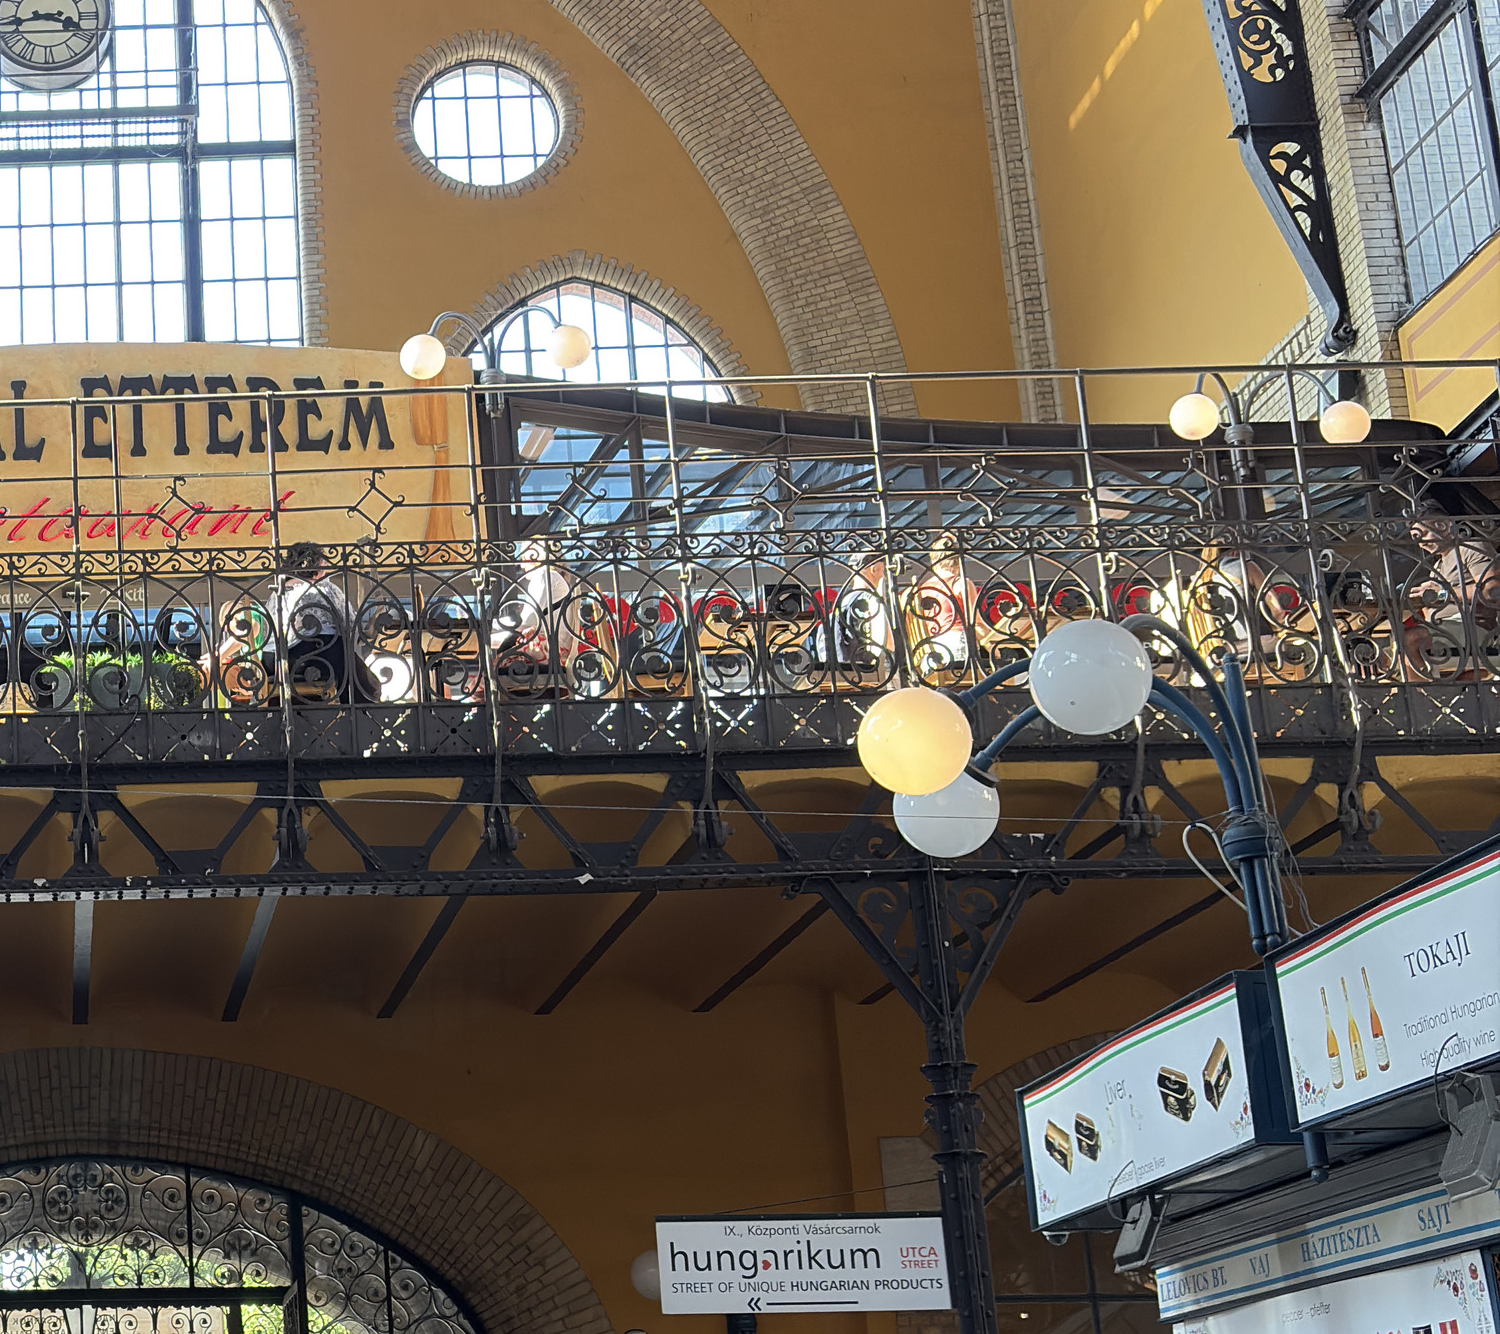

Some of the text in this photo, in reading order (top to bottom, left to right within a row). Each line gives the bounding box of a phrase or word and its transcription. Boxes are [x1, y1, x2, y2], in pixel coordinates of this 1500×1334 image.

[80, 373, 395, 458] ETTEREM
[1403, 931, 1471, 978] TOKAJI
[1403, 991, 1500, 1039] Traditional Hungarian
[1419, 1029, 1496, 1068] High quality wine
[747, 1224, 800, 1241] Központi
[804, 1222, 882, 1236] Vásárcsarnok
[670, 1240, 881, 1280] hungarikum
[899, 1246, 938, 1259] UTCA
[900, 1259, 939, 1270] STREET
[1160, 1274, 1209, 1303] LELOVICS
[1249, 1253, 1270, 1279] VAJ
[1301, 1222, 1381, 1264] HÁZITÉSZTA
[1417, 1203, 1451, 1233] SAJT
[672, 1277, 943, 1295] STREET OF UNIQUE HUNGARIAN PRODUCTS
